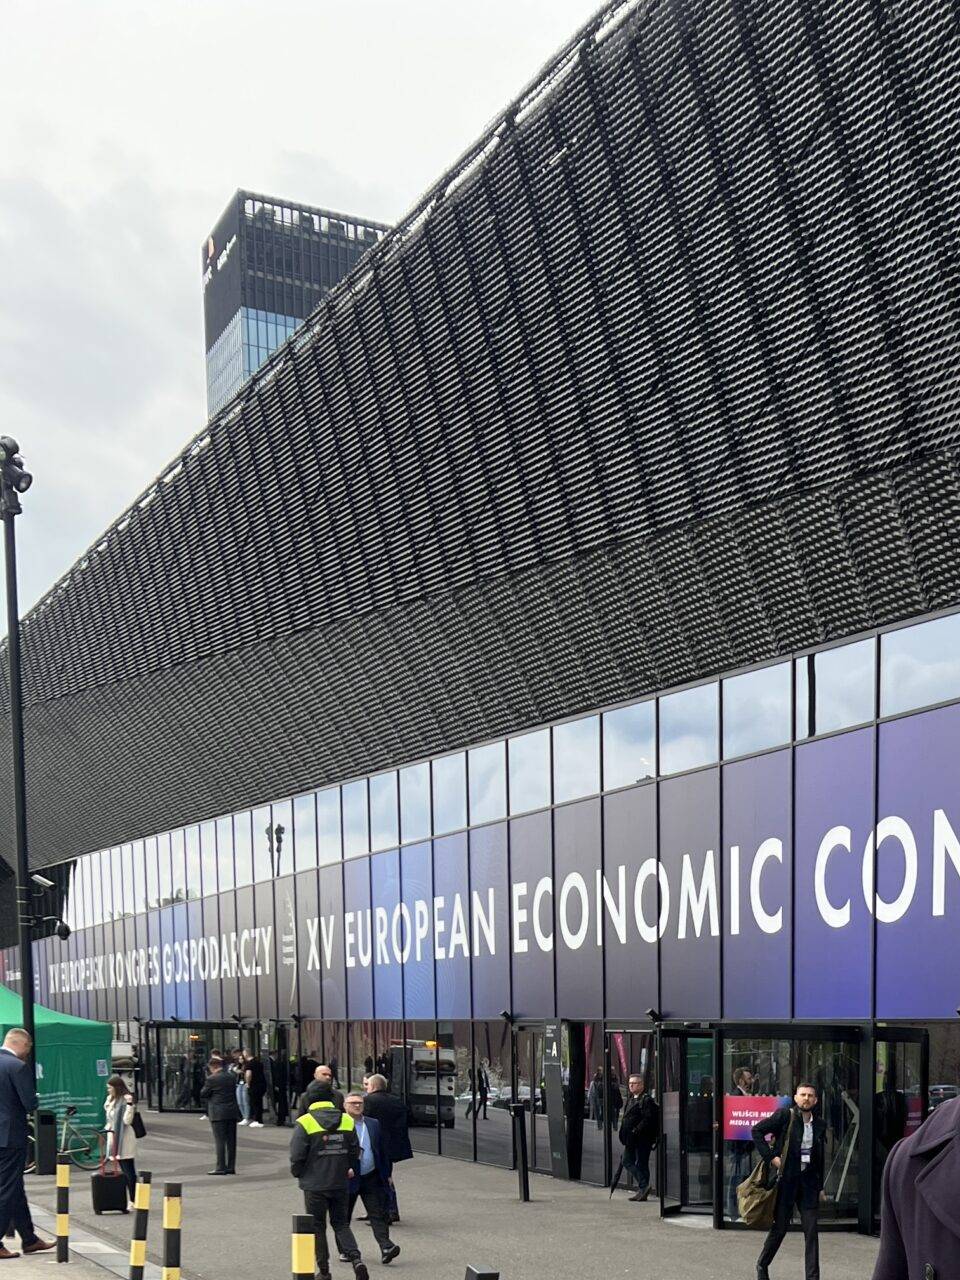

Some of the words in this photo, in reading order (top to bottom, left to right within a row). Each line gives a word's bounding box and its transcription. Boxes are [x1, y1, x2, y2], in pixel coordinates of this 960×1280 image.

[306, 915, 336, 971] XV
[344, 887, 496, 969] EUROPEAN
[513, 837, 784, 954] ECONOMIC
[49, 964, 60, 994] XV
[109, 946, 160, 989] KONGRES
[163, 926, 272, 984] GOSPODARCZY
[551, 1041, 558, 1058] A
[732, 1109, 758, 1118] WEJŚCIE
